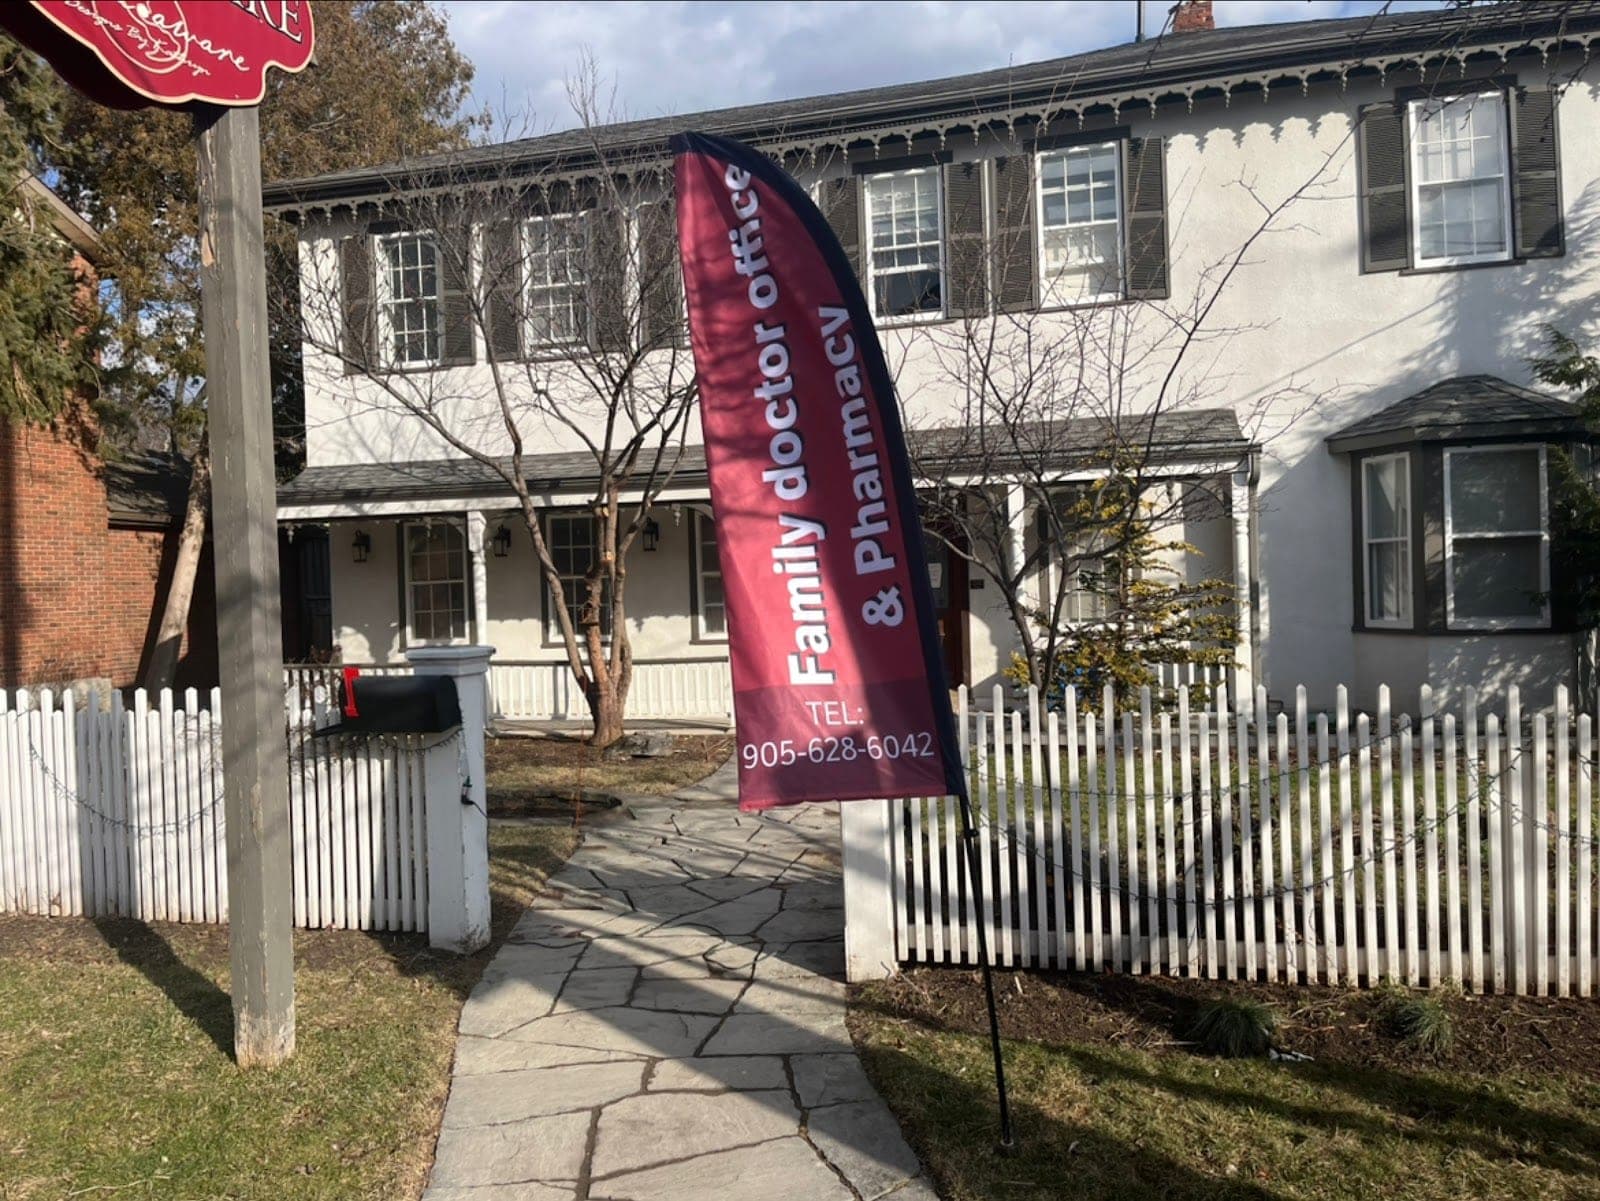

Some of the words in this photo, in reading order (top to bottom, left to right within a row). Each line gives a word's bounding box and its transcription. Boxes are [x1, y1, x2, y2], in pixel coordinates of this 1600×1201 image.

[725, 163, 779, 310] office
[753, 322, 808, 501] doctor
[771, 514, 836, 686] Family
[861, 585, 905, 628] &
[742, 731, 936, 769] 905-628-6042
[805, 699, 865, 726] TEL:
